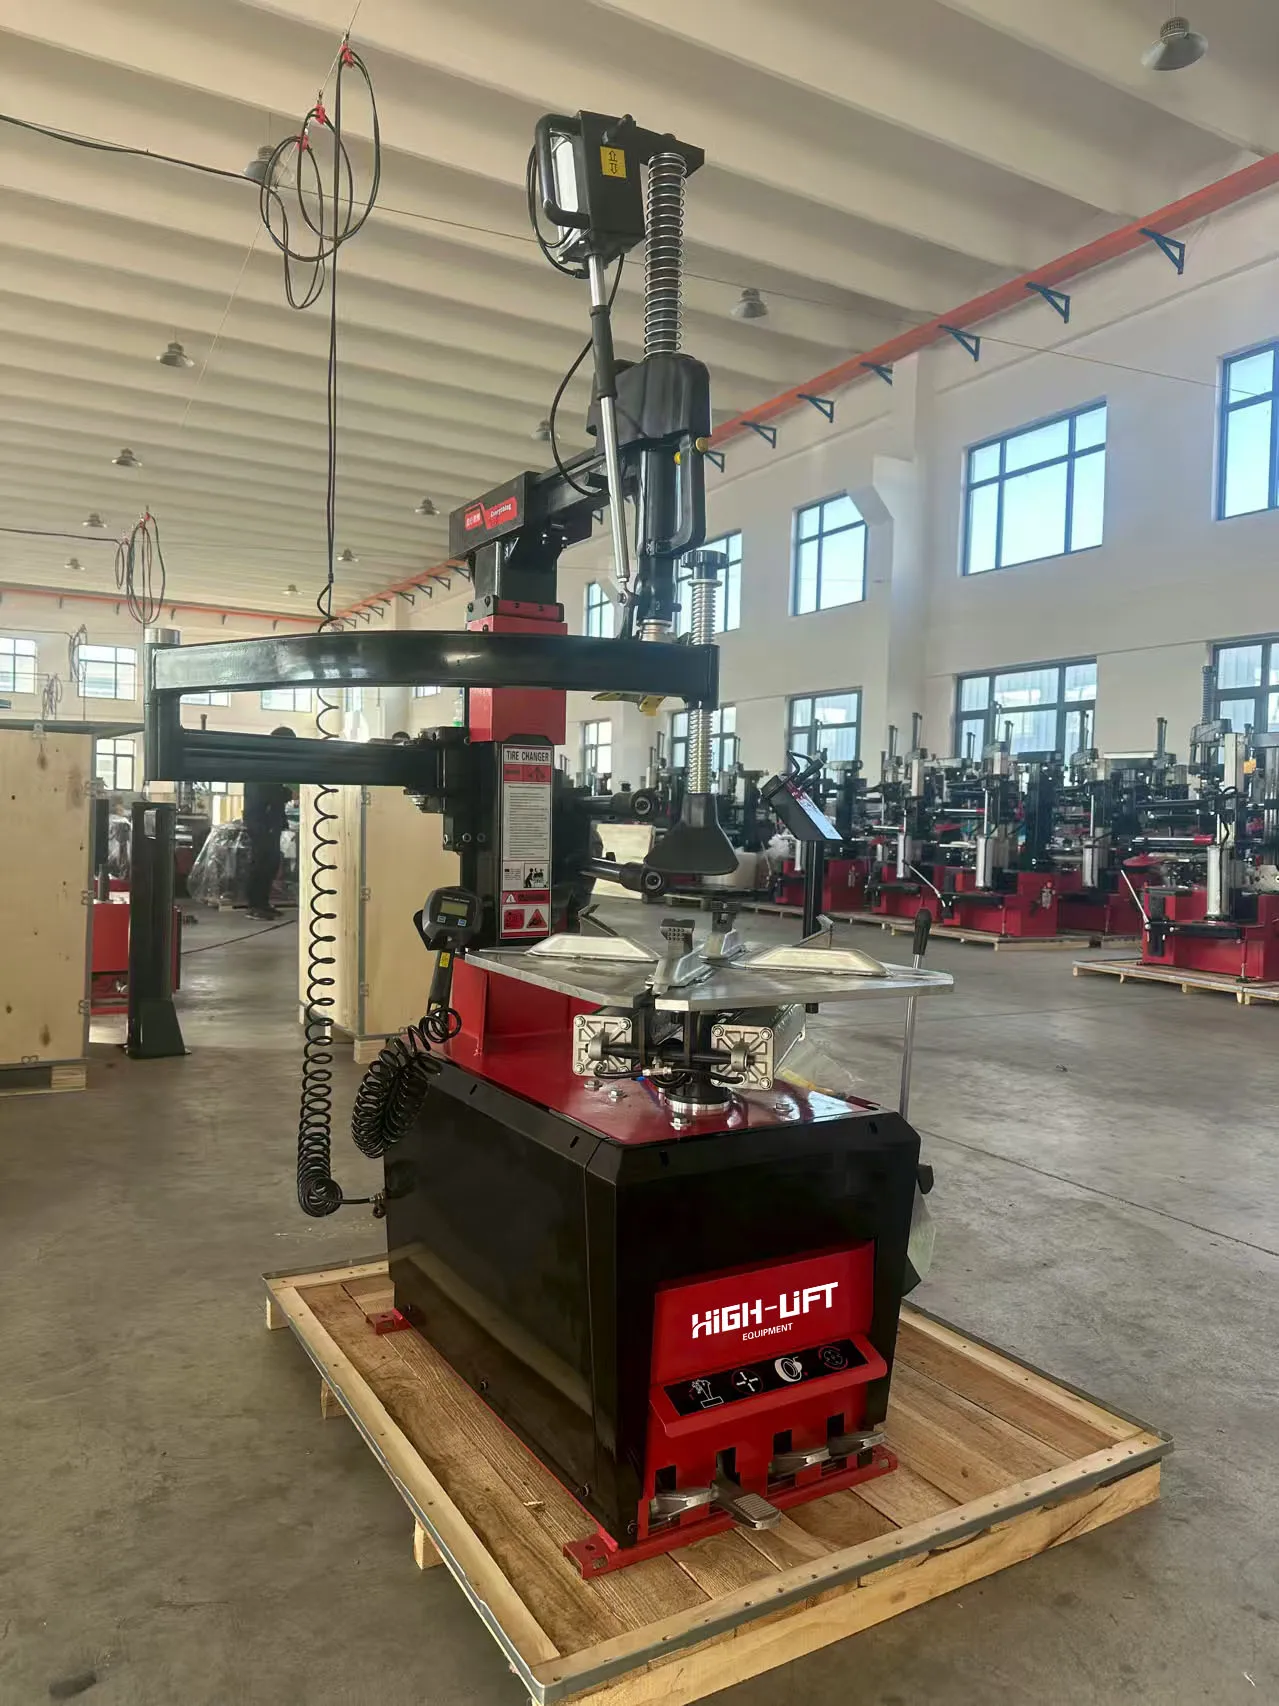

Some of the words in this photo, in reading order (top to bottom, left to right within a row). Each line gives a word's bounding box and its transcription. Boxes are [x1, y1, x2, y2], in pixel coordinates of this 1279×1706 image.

[506, 750, 520, 761] TIRE
[521, 751, 549, 762] CHANGER
[742, 1322, 794, 1341] EQUIPMENT
